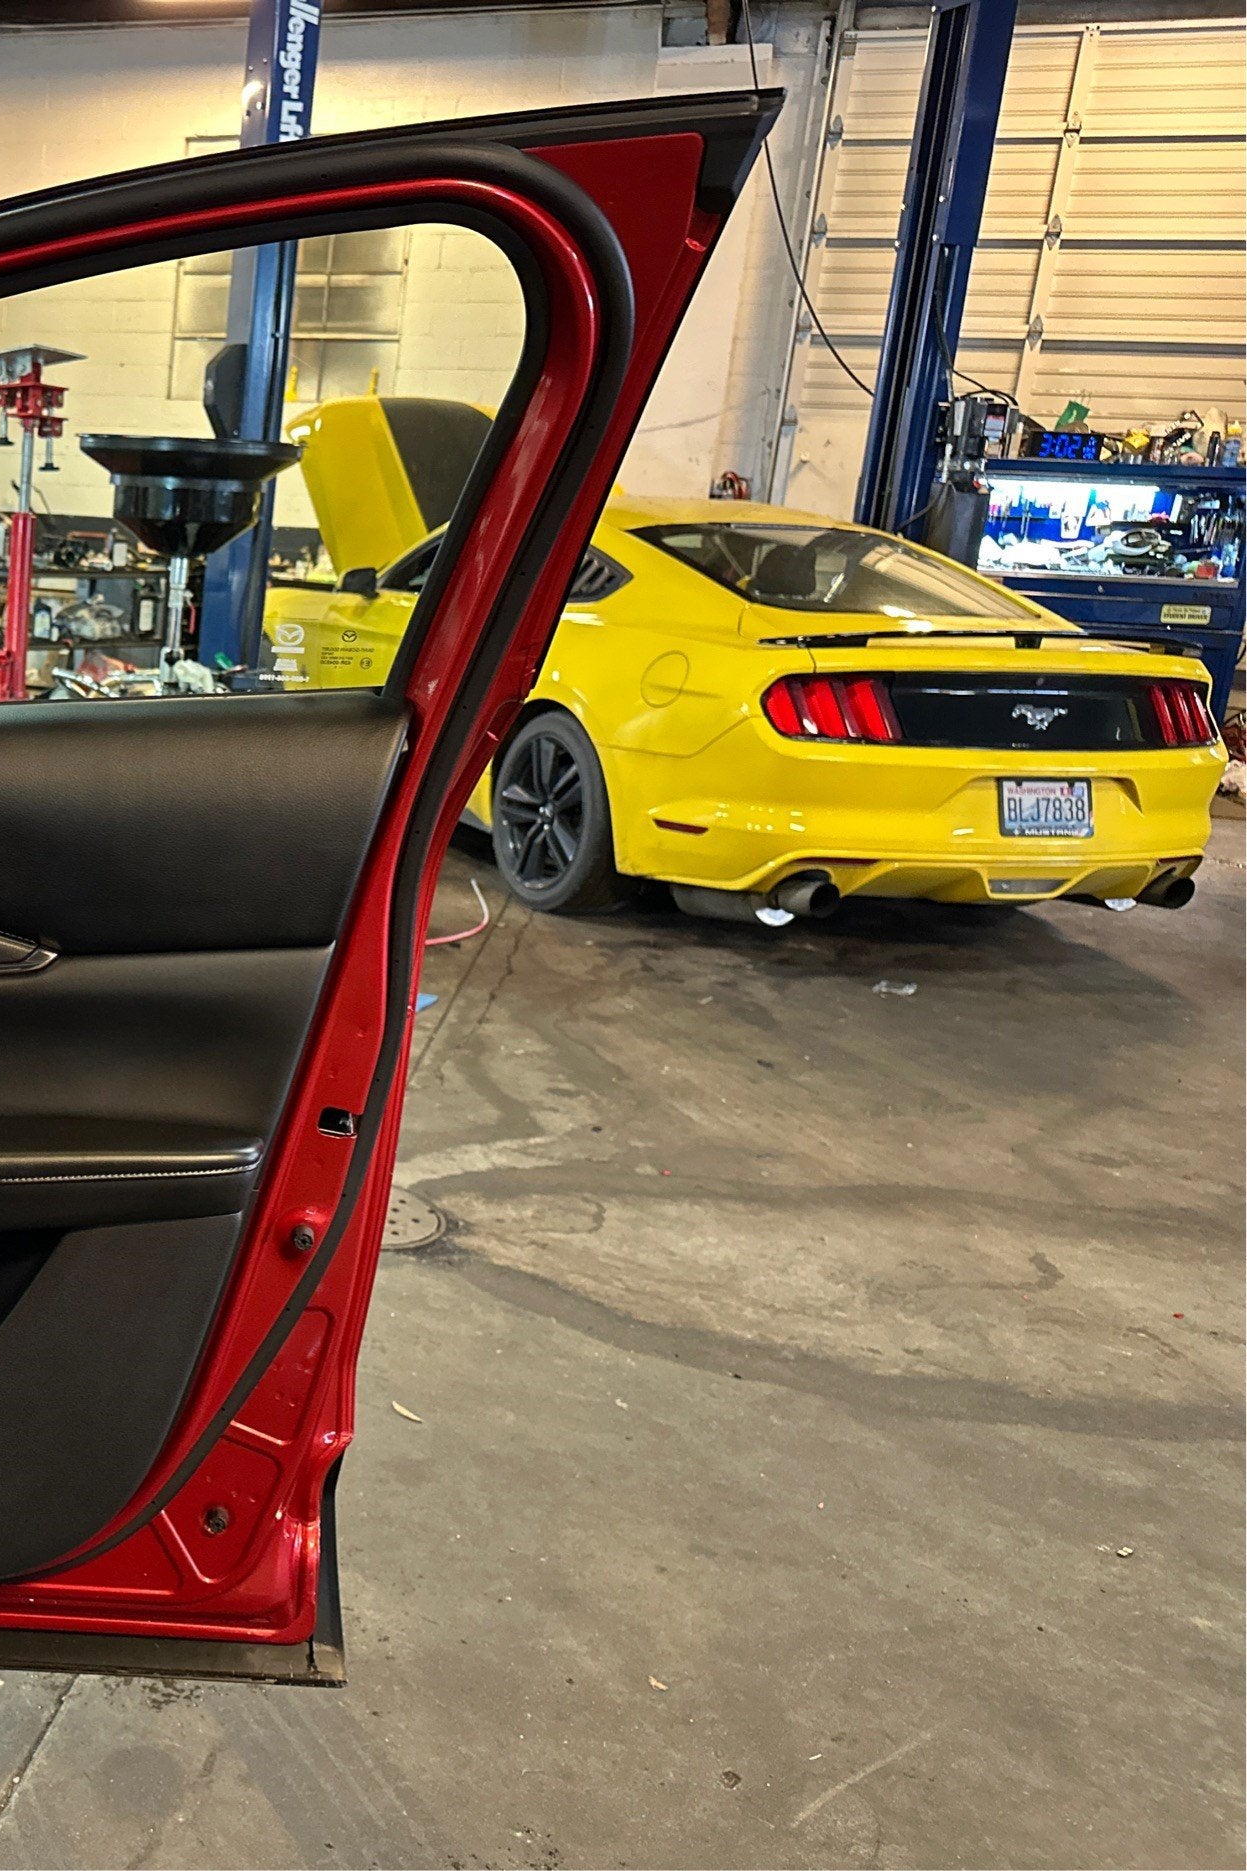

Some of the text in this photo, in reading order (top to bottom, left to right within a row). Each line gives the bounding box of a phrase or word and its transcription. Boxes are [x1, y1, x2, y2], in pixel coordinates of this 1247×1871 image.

[279, 0, 320, 99] llenger
[1038, 433, 1082, 458] 3:02
[1007, 786, 1056, 795] WASHINGTON
[1007, 797, 1085, 822] BLJ7838
